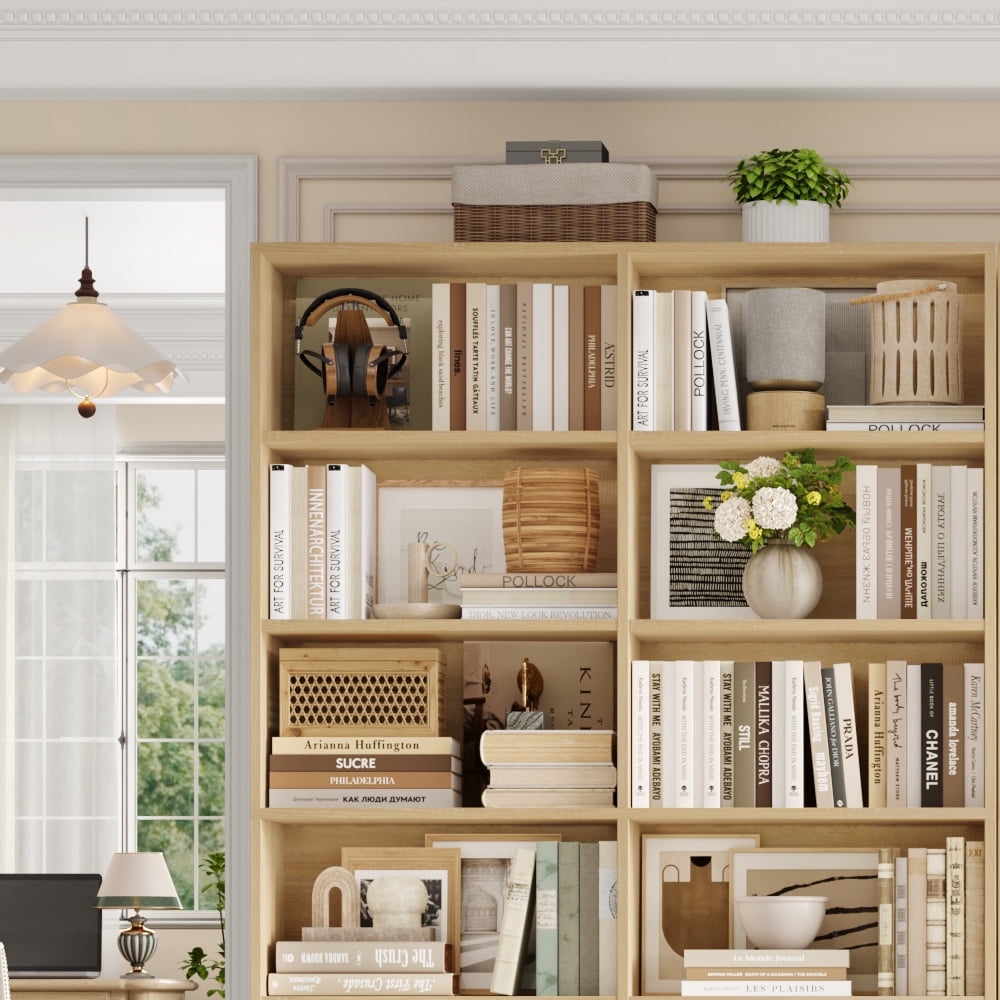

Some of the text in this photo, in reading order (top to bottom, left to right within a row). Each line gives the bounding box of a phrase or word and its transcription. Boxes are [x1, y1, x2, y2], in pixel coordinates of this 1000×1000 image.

[438, 320, 446, 408] exploring black sand beaches
[454, 350, 462, 377] lines.
[472, 341, 480, 361] TARTE
[588, 335, 596, 388] PHILADELPHIA
[694, 330, 704, 397] POLLOCK
[472, 363, 480, 382] TATIN
[637, 349, 648, 427] ART FOR SURVIVAL
[309, 489, 324, 614] INNENARCHITEKTUR
[274, 530, 284, 613] ART FOR SURVIVAL
[330, 530, 340, 613] ART FOR SURVIVAL
[502, 576, 576, 588] POLLOCK
[522, 610, 549, 619] LOOK
[551, 610, 612, 619] REVOLUTION
[825, 677, 834, 697] JOHN
[827, 698, 836, 737] GALLIANO
[968, 675, 981, 741] Karen McCartney
[304, 740, 420, 752] Arianna Huffington
[652, 673, 660, 801] STAY WITH ME AYOBAMI ADEBAYO
[723, 673, 732, 801] STAY WITH ME AYOBAMI ADEBAYO
[739, 725, 750, 751] STILL
[758, 685, 770, 785] MALLIKA CHOPRA
[808, 686, 821, 709] Sigrid
[815, 752, 829, 792] mayhem
[843, 719, 854, 760] PRADA
[872, 690, 884, 784] Arianna Huffington
[948, 702, 959, 776] amanda lovelace
[336, 758, 376, 769] SUCRE
[831, 748, 840, 768] DIOR
[926, 729, 939, 790] CHANEL
[329, 776, 395, 785] PHILADELPHIA
[301, 952, 349, 963] SANDRA BROWN
[375, 948, 435, 967] The Crush
[733, 954, 805, 962] Le Monde Journal
[343, 978, 434, 992] The First Crusade
[746, 985, 766, 993] LES
[772, 985, 825, 993] PLAISIRS
